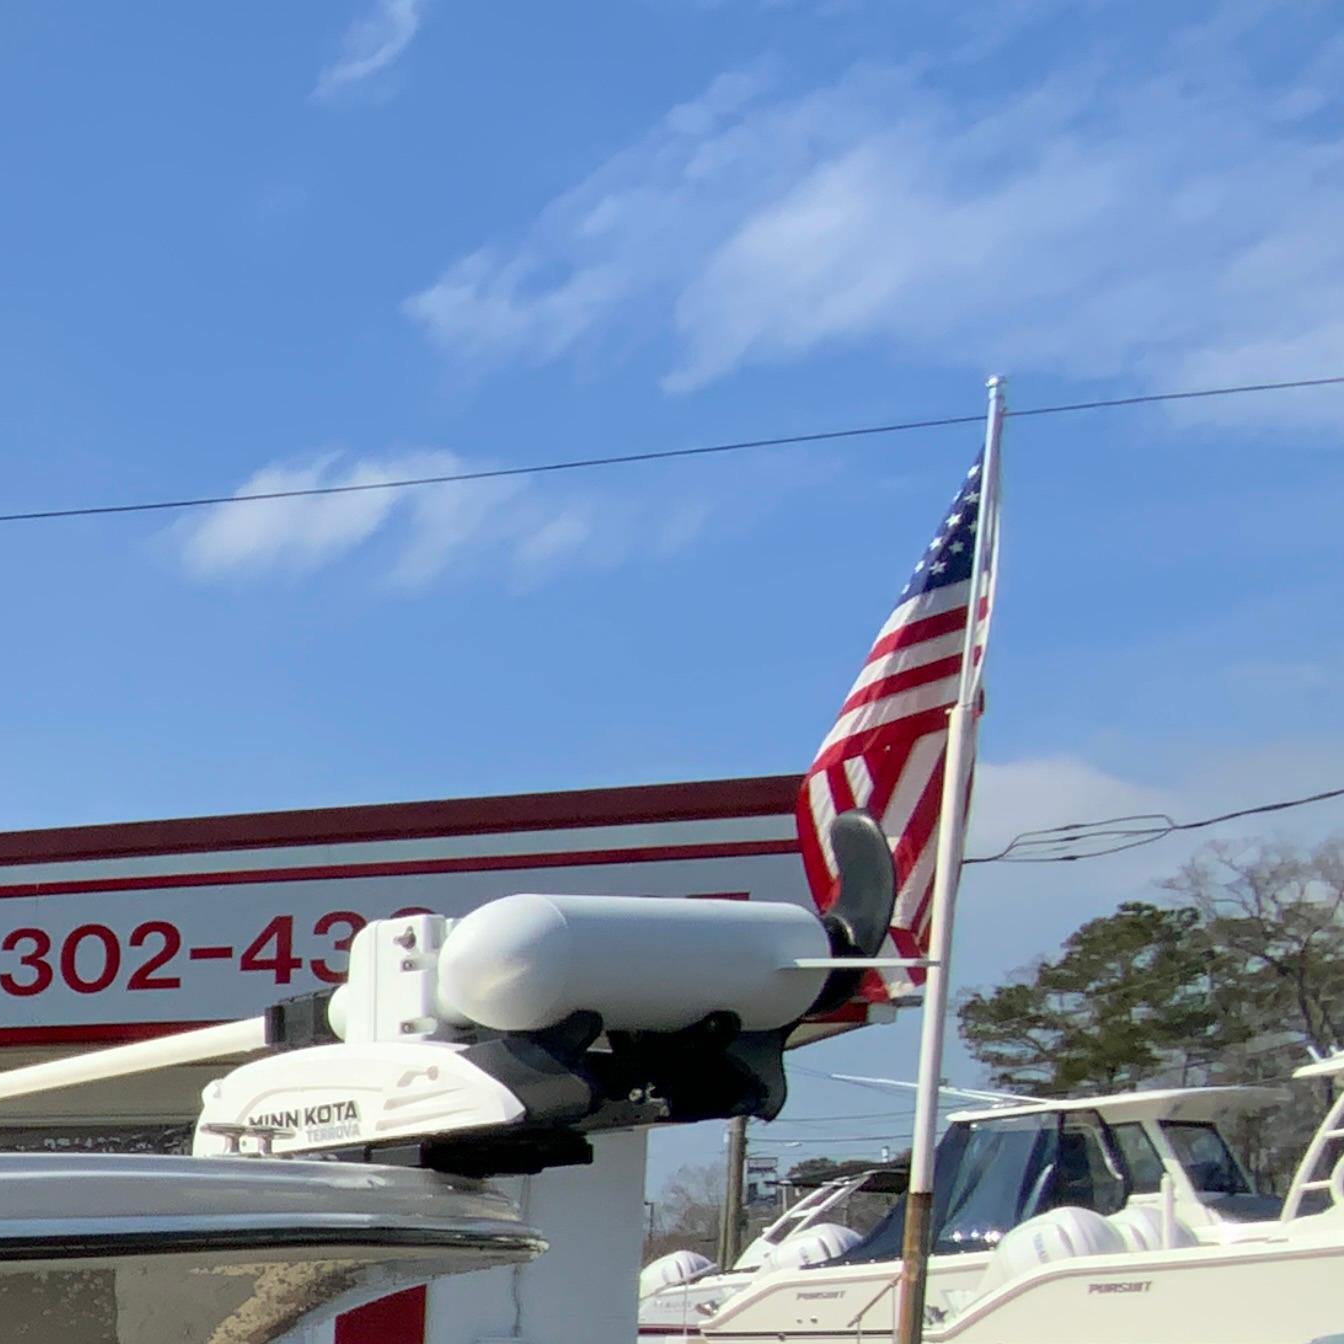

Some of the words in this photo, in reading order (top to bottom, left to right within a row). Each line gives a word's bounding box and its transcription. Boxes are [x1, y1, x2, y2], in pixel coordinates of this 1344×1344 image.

[0, 907, 435, 997] 302-43
[249, 1109, 299, 1127] MINN
[304, 1100, 358, 1126] KOTA
[1087, 1281, 1153, 1295] PURSUIT
